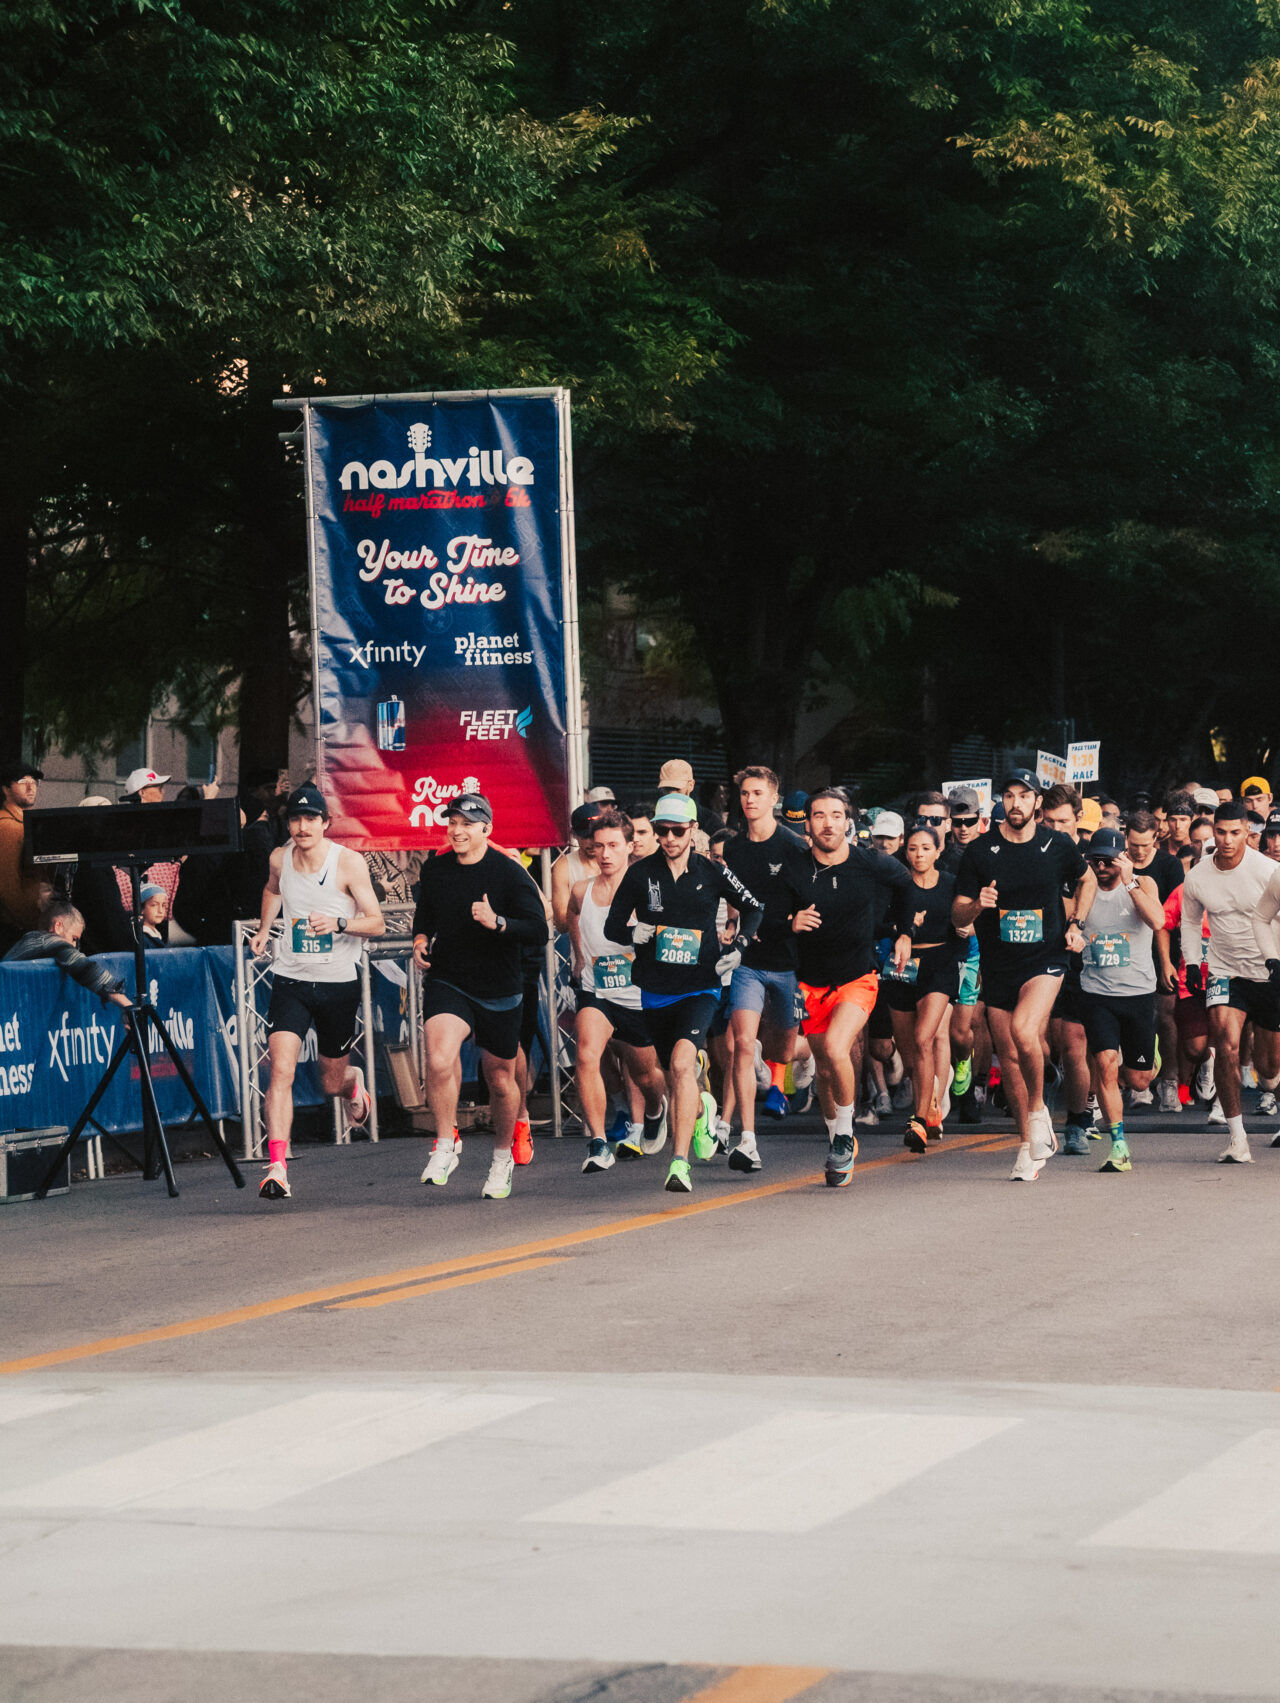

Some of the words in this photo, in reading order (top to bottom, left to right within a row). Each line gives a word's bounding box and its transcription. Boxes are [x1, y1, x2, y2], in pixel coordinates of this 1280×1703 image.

[338, 446, 534, 490] nashville
[343, 492, 385, 519] half
[388, 489, 487, 510] marathon
[357, 538, 439, 582] Your
[446, 534, 520, 575] Time
[383, 578, 417, 606] to
[420, 572, 506, 610] Shine
[454, 632, 519, 654] planet
[349, 640, 427, 669] xfinity
[464, 649, 533, 666] fitness
[459, 709, 518, 726] FLEET
[465, 725, 513, 741] FEET
[1072, 753, 1095, 767] 1:30
[1072, 770, 1094, 780] HALF
[411, 776, 461, 805] Run
[1008, 929, 1035, 942] 1327
[301, 939, 321, 953] 315
[660, 948, 692, 963] 2088
[1099, 953, 1120, 966] 729
[602, 974, 627, 988] 1919
[48, 1011, 115, 1082] xfinity
